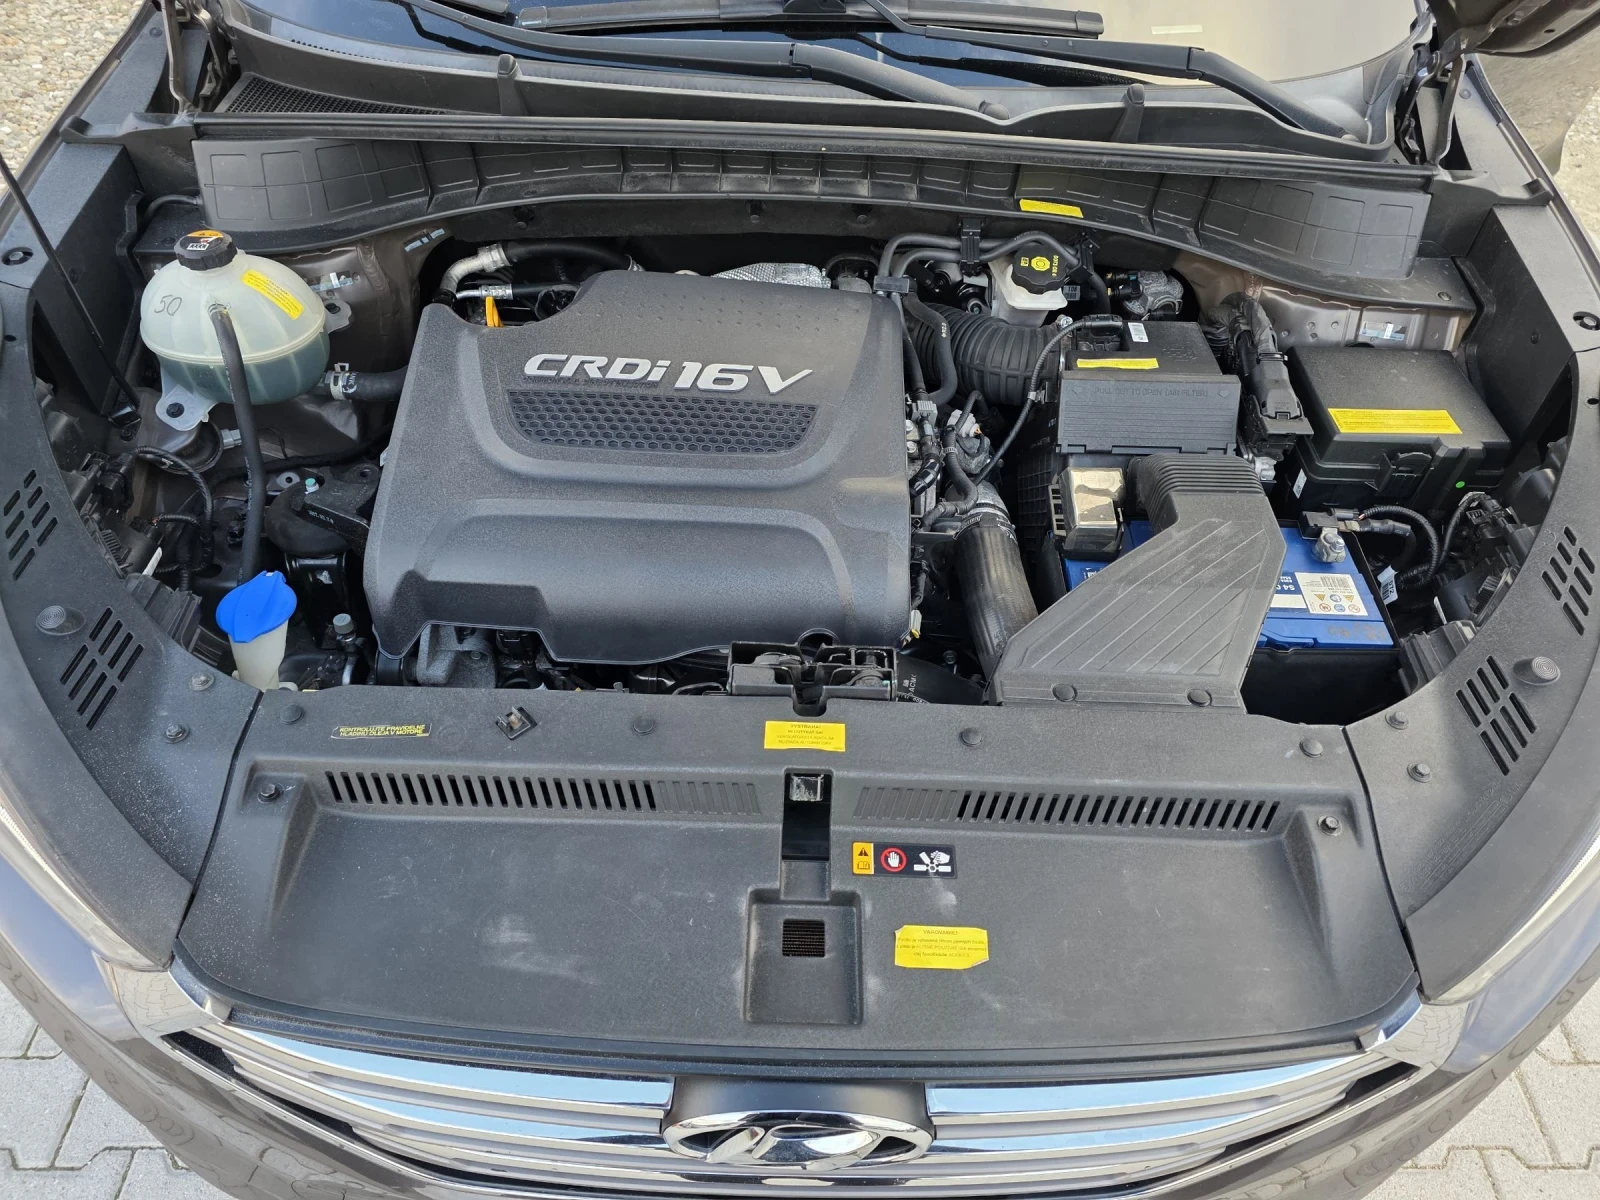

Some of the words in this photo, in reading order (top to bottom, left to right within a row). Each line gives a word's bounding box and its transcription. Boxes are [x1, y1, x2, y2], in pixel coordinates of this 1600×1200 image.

[154, 294, 183, 317] 50
[524, 353, 671, 382] CRDi
[1093, 387, 1113, 395] PULL
[1114, 388, 1129, 396] OUT
[1131, 388, 1141, 396] TO
[1142, 388, 1163, 396] OPEN
